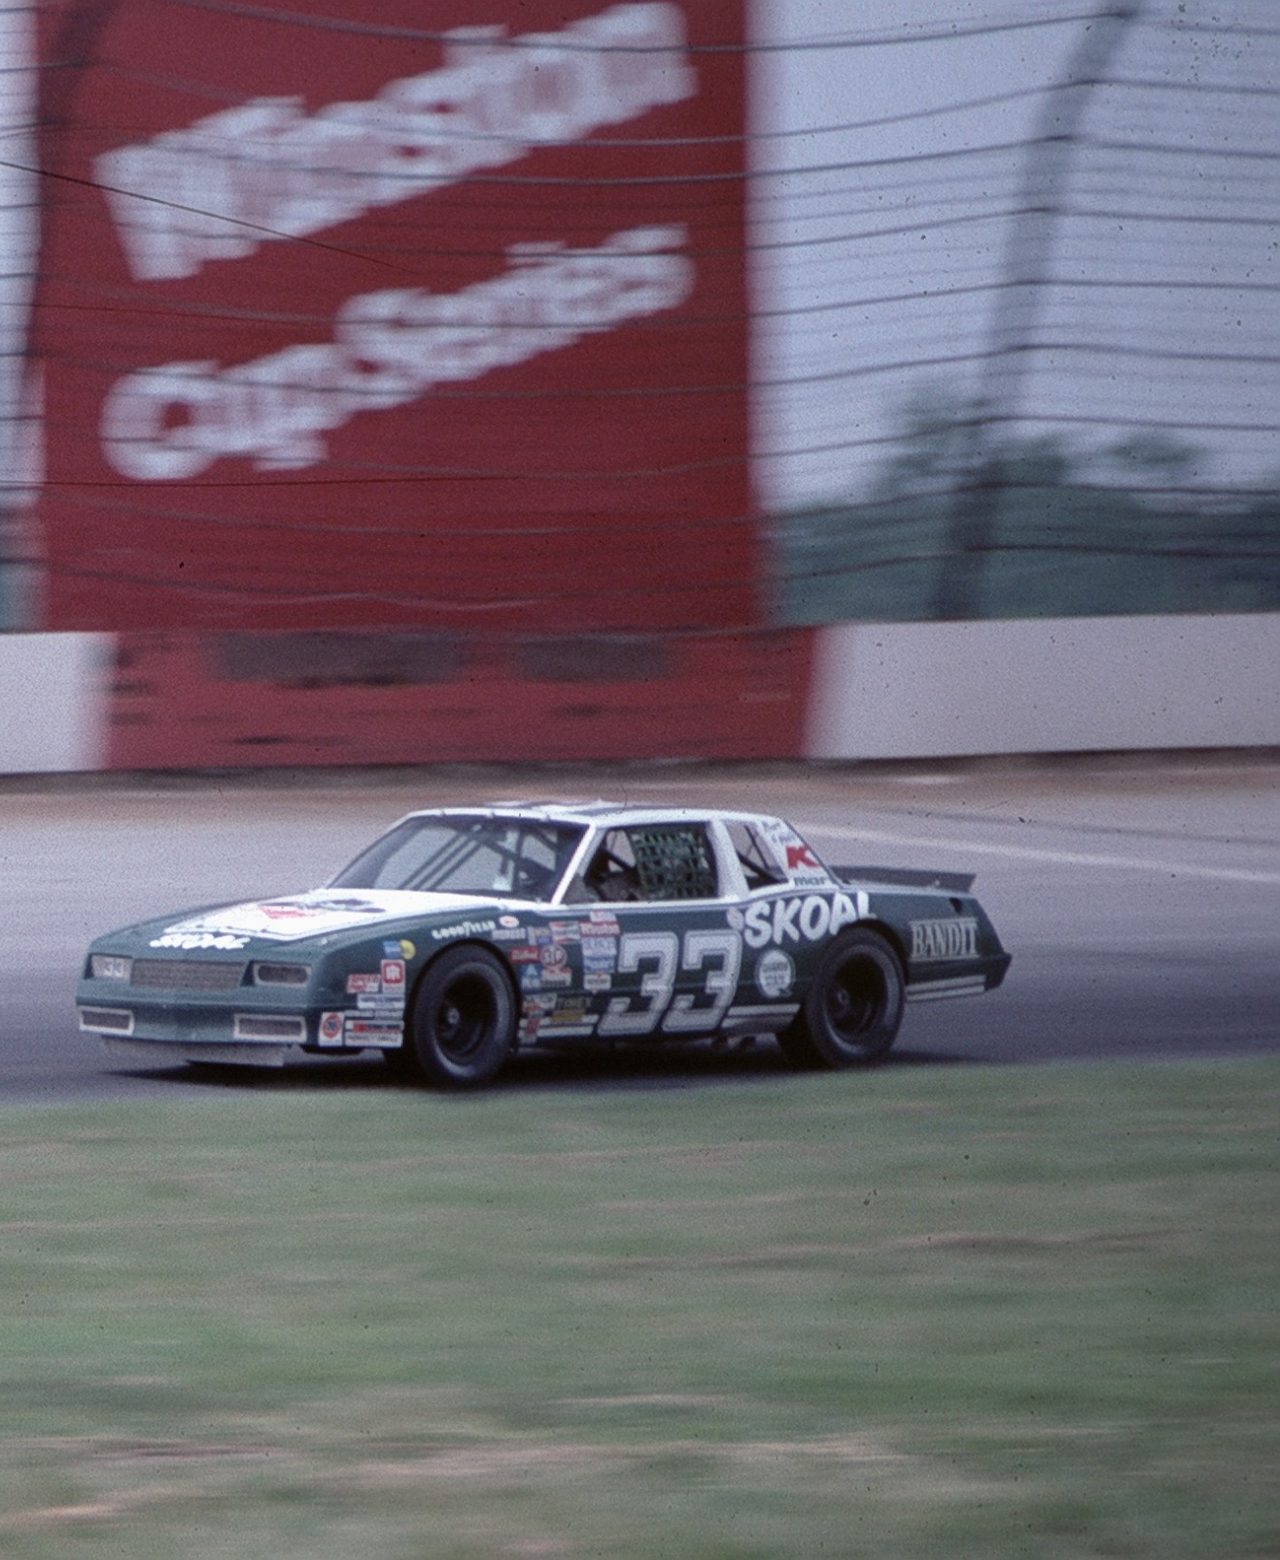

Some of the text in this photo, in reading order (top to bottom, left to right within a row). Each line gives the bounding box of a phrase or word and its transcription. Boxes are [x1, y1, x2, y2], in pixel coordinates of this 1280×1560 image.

[744, 891, 876, 948] SKOAL
[911, 920, 979, 958] BANDIT
[598, 930, 742, 1036] 33
